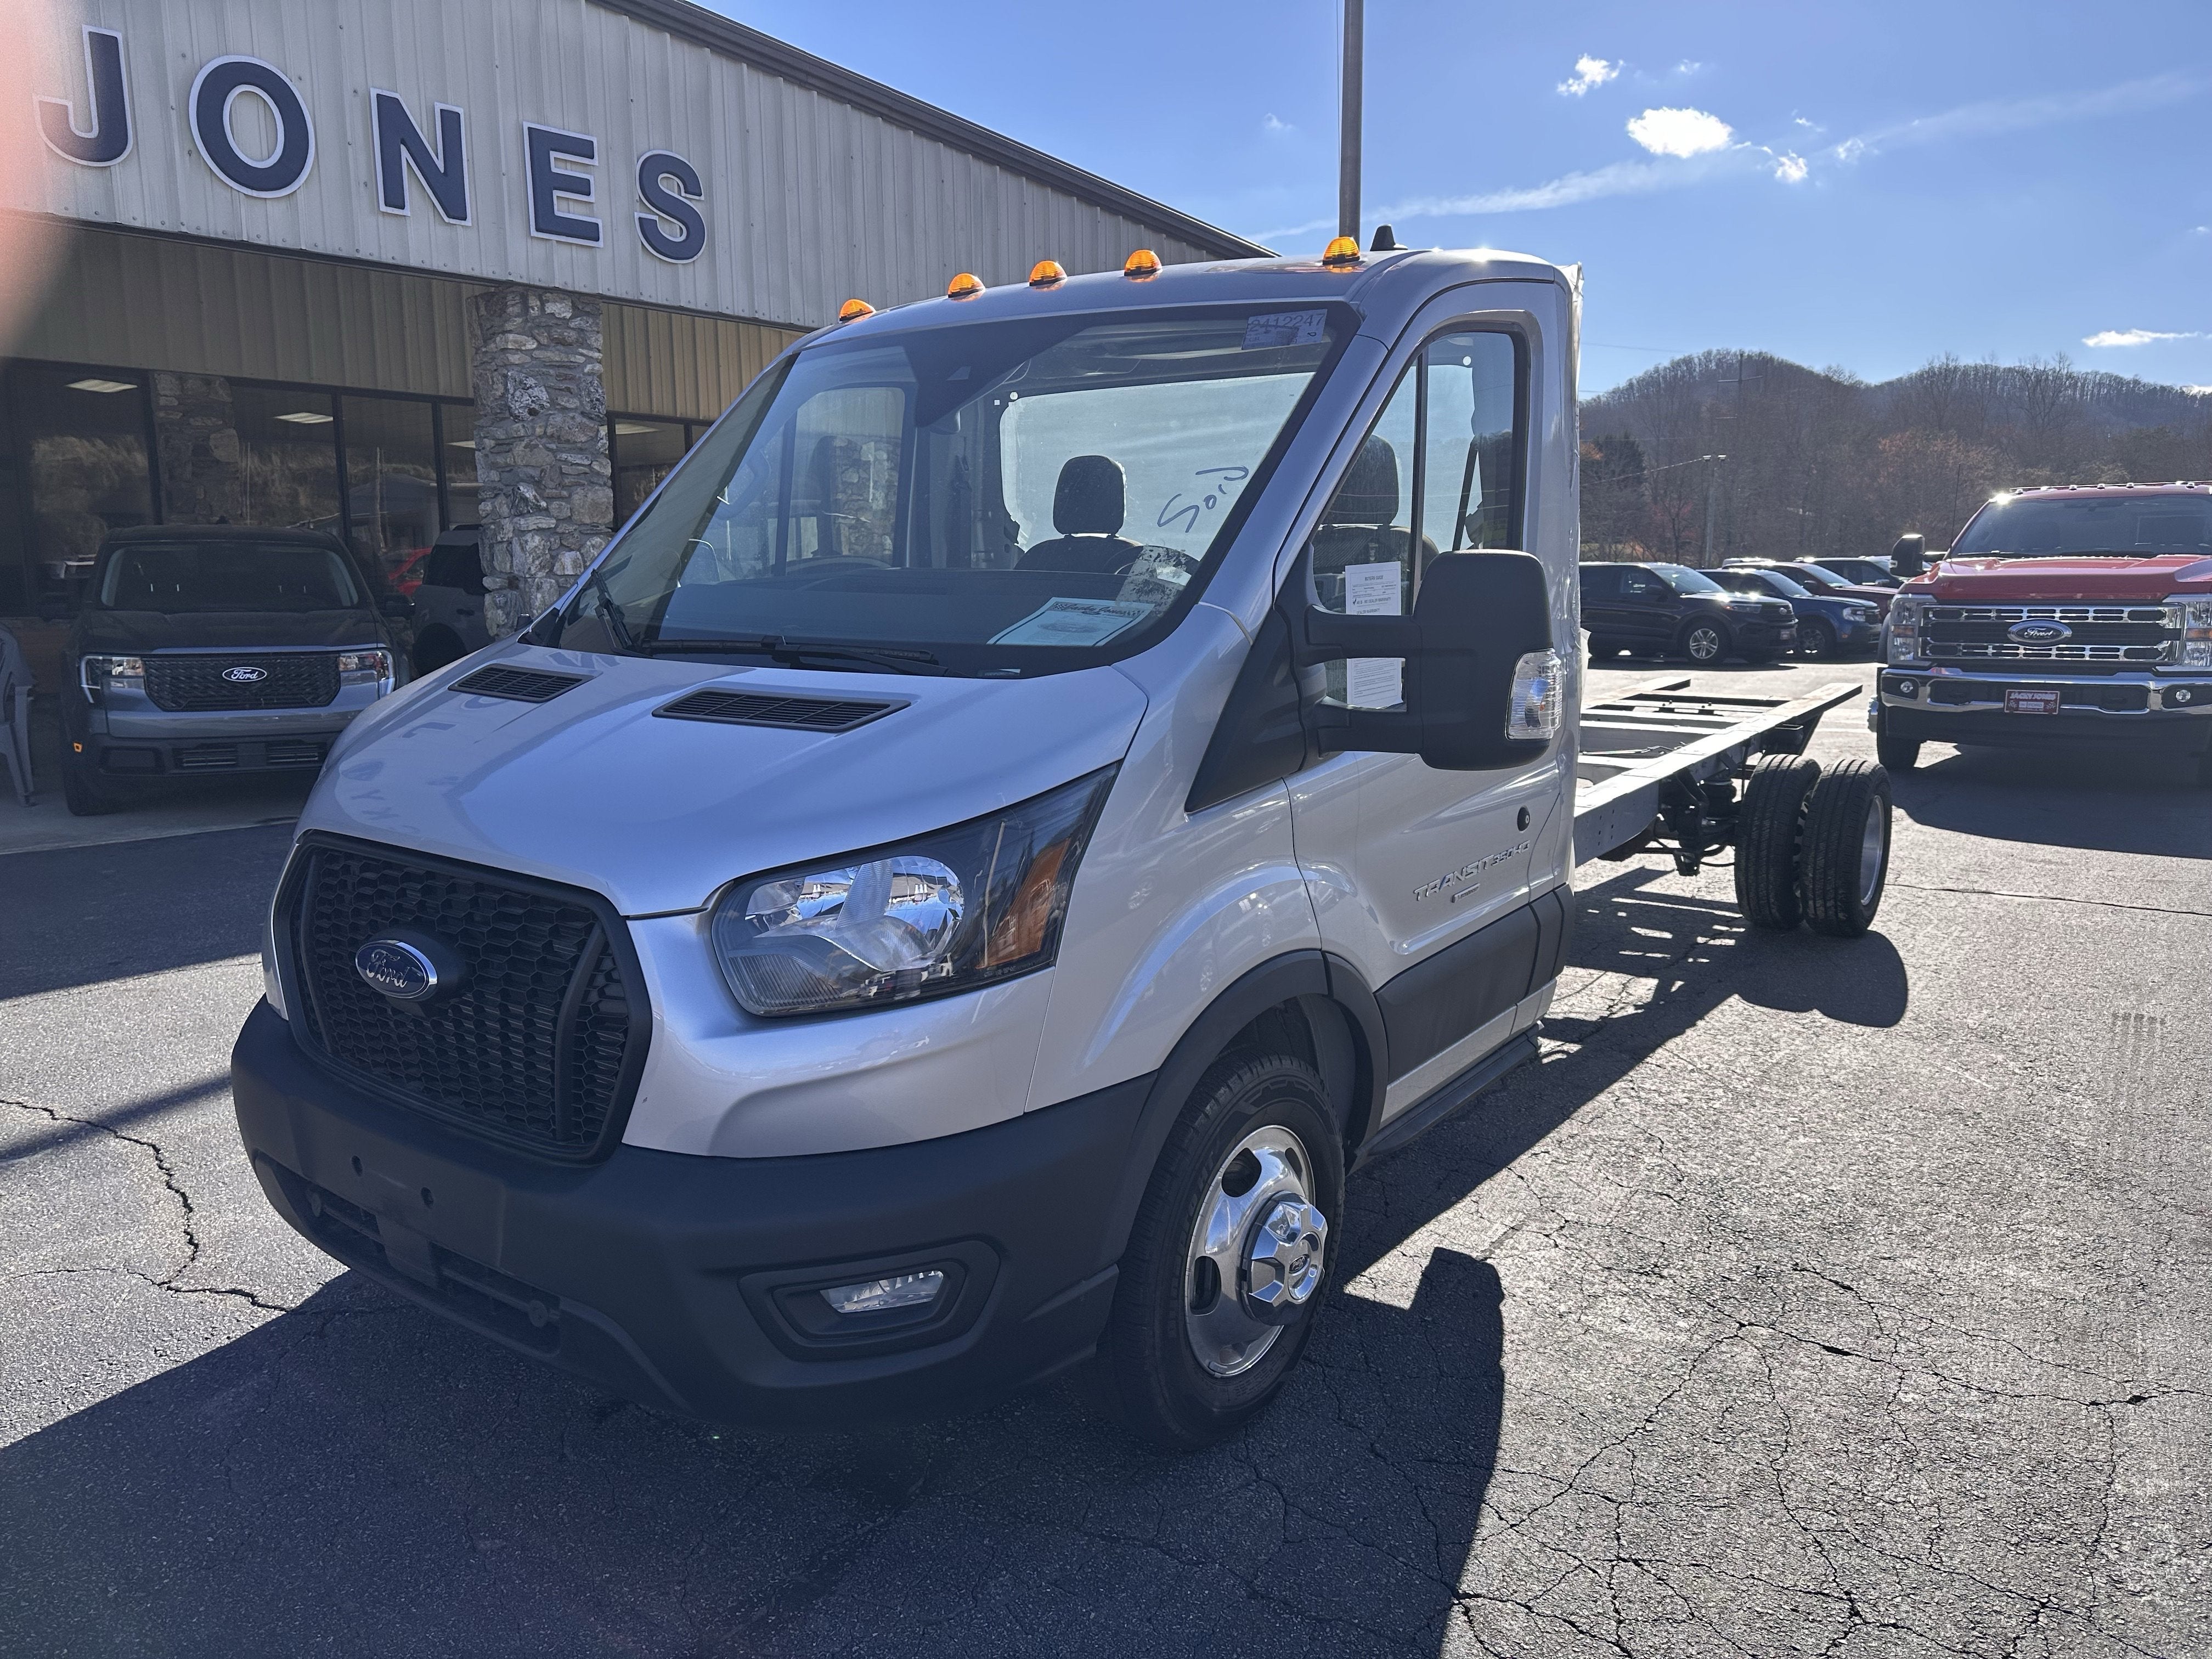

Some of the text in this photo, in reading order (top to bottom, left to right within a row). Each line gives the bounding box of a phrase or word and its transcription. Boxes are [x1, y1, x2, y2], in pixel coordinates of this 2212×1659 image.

[34, 24, 707, 264] JONES
[2024, 627, 2053, 636] Ford
[231, 669, 259, 679] Ford
[1413, 854, 1496, 901] TRANSIT
[1491, 840, 1531, 866] 350HD
[366, 949, 408, 988] Ford
